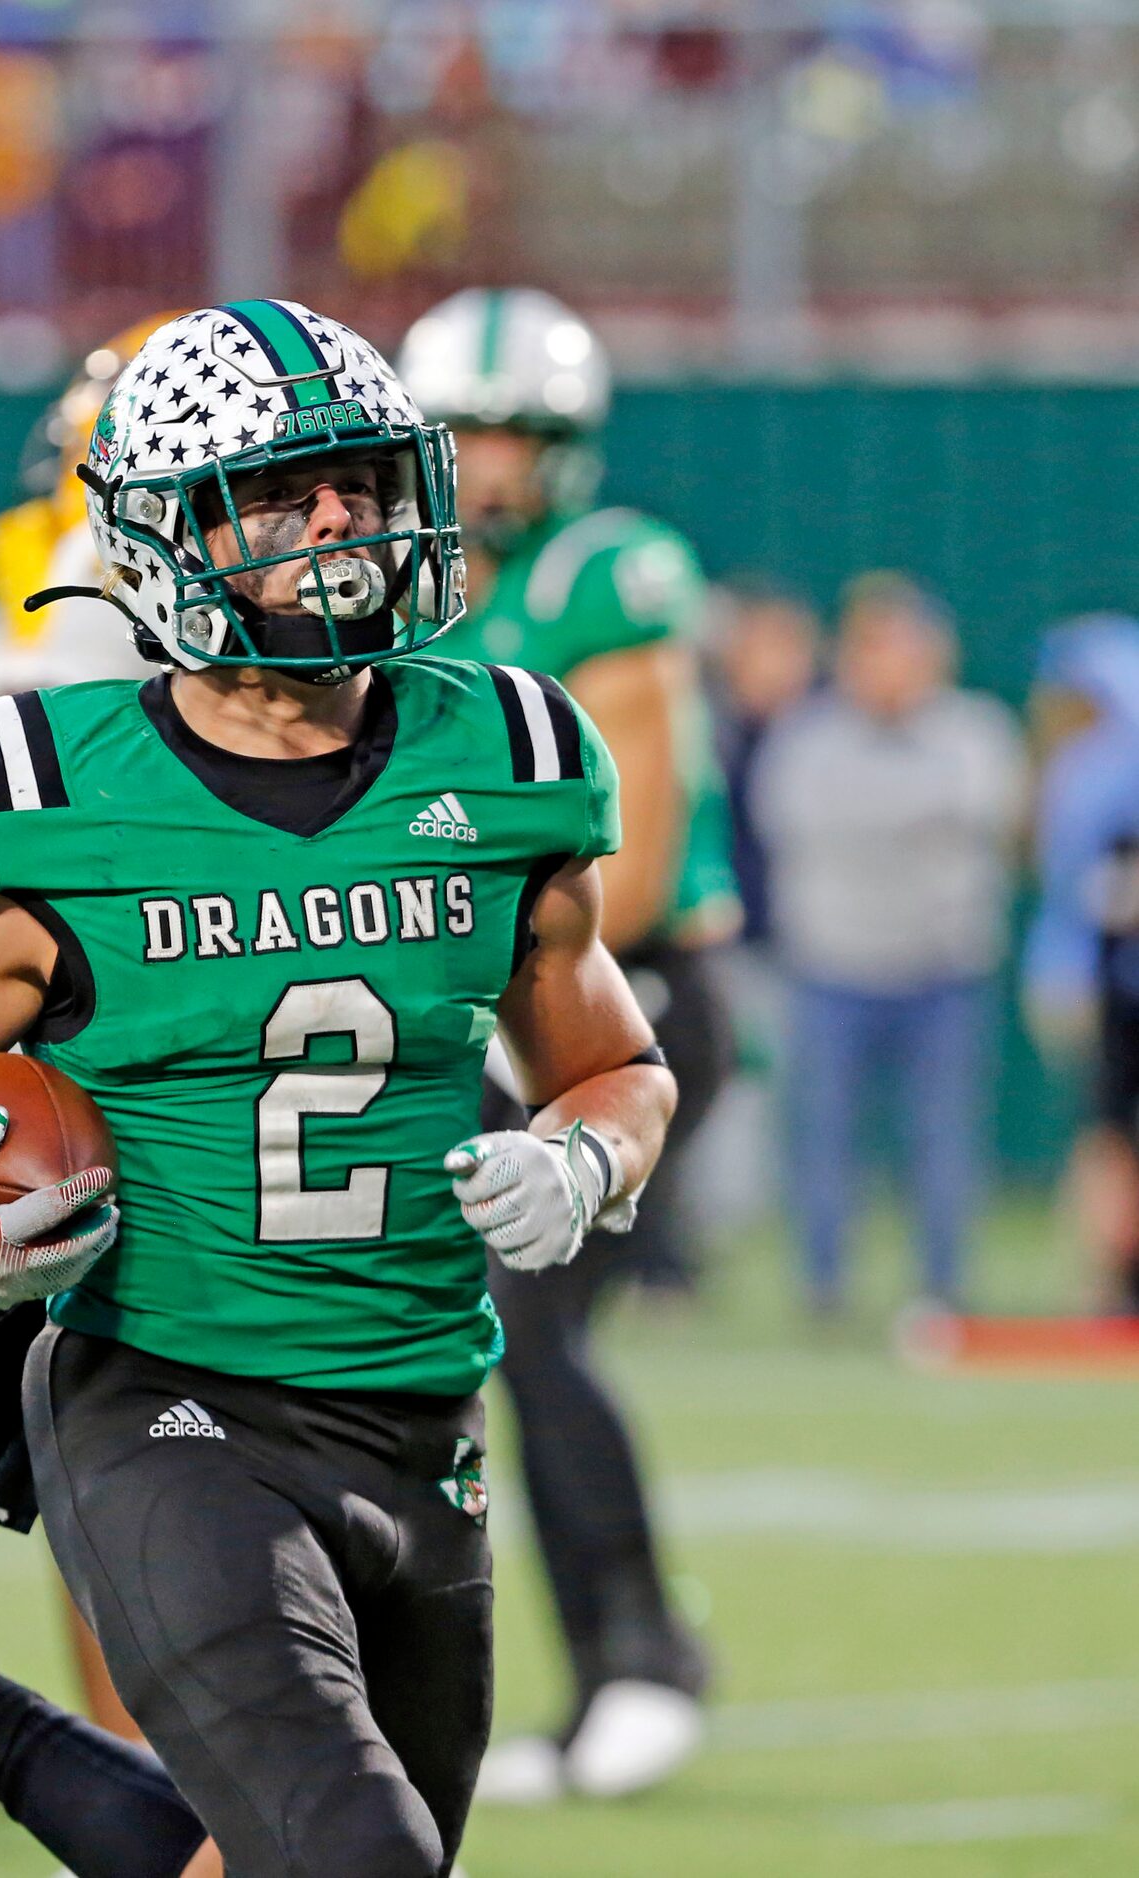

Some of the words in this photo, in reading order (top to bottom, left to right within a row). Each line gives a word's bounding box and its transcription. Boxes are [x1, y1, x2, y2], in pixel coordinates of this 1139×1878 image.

[278, 402, 365, 437] 76092
[409, 818, 478, 842] adidas
[142, 873, 475, 963] DRAGONS
[254, 975, 398, 1245] 2
[149, 1419, 226, 1440] adidas
